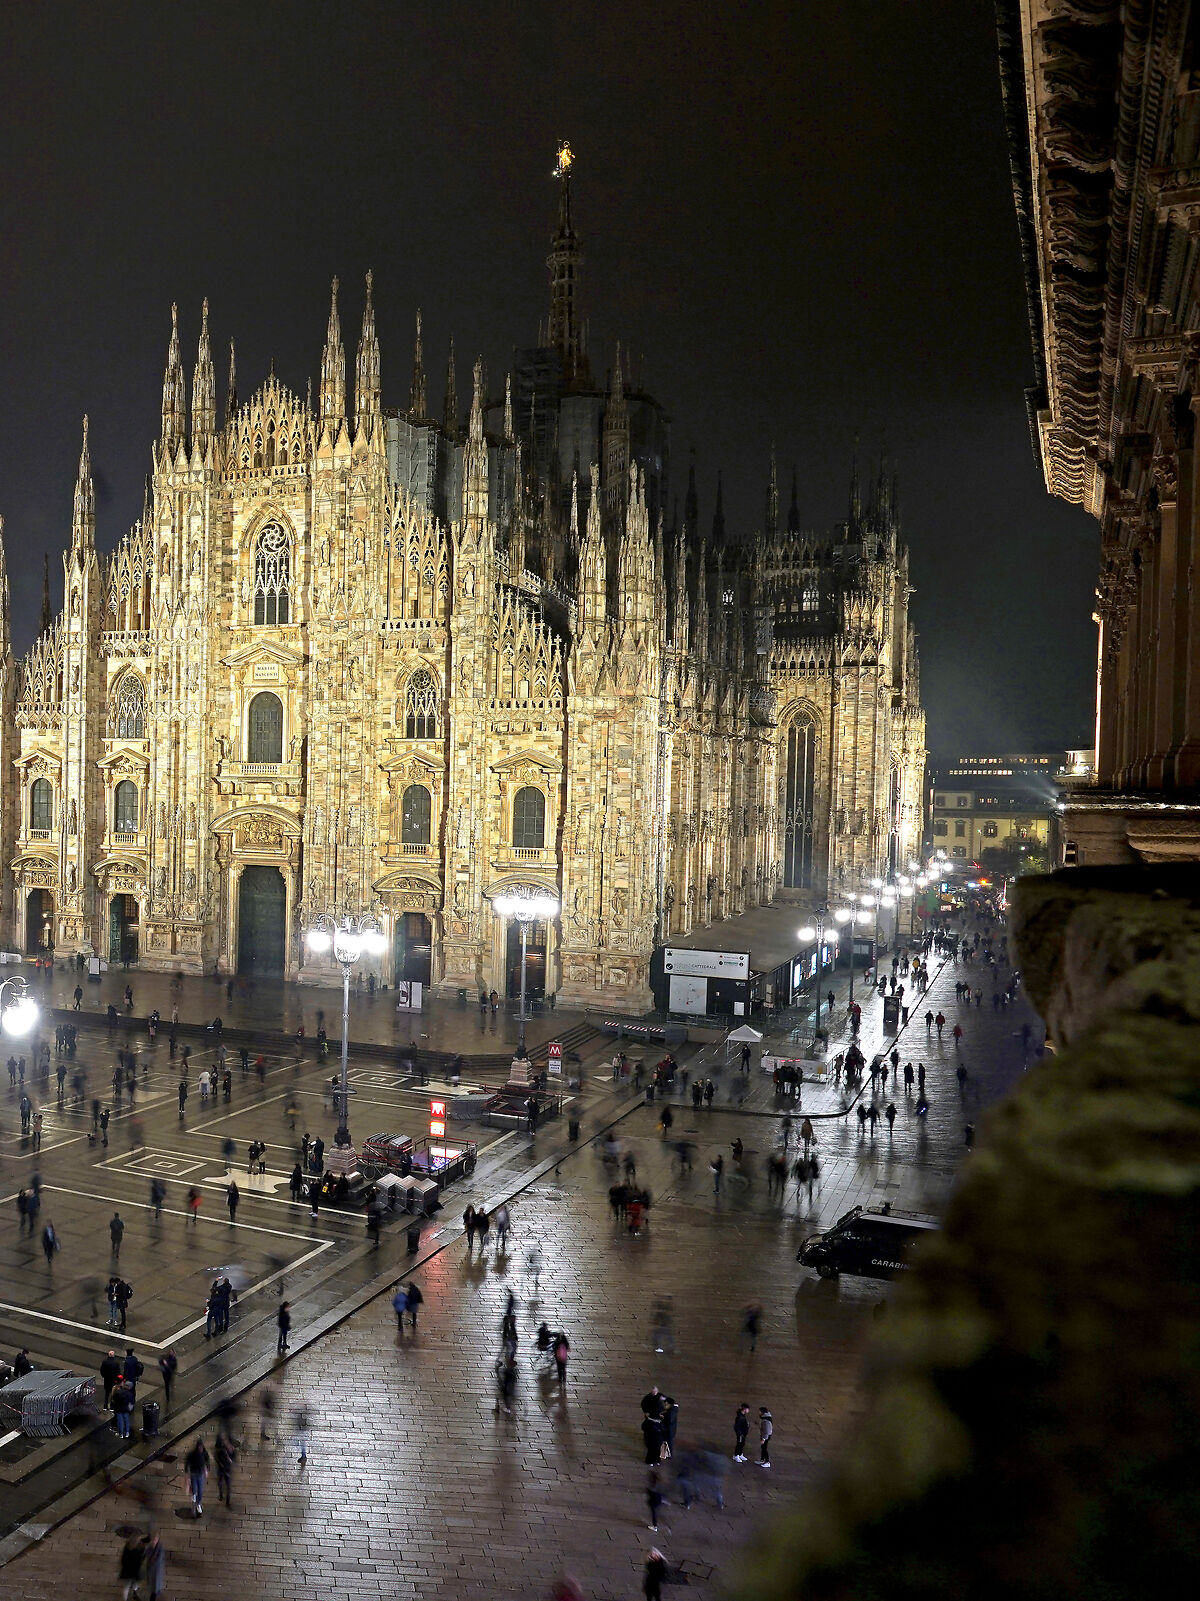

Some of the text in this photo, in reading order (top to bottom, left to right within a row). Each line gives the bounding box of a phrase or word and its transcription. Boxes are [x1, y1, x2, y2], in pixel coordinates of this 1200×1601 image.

[550, 1046, 561, 1055] M
[431, 1102, 445, 1115] M
[871, 1258, 911, 1270] CARABIN
